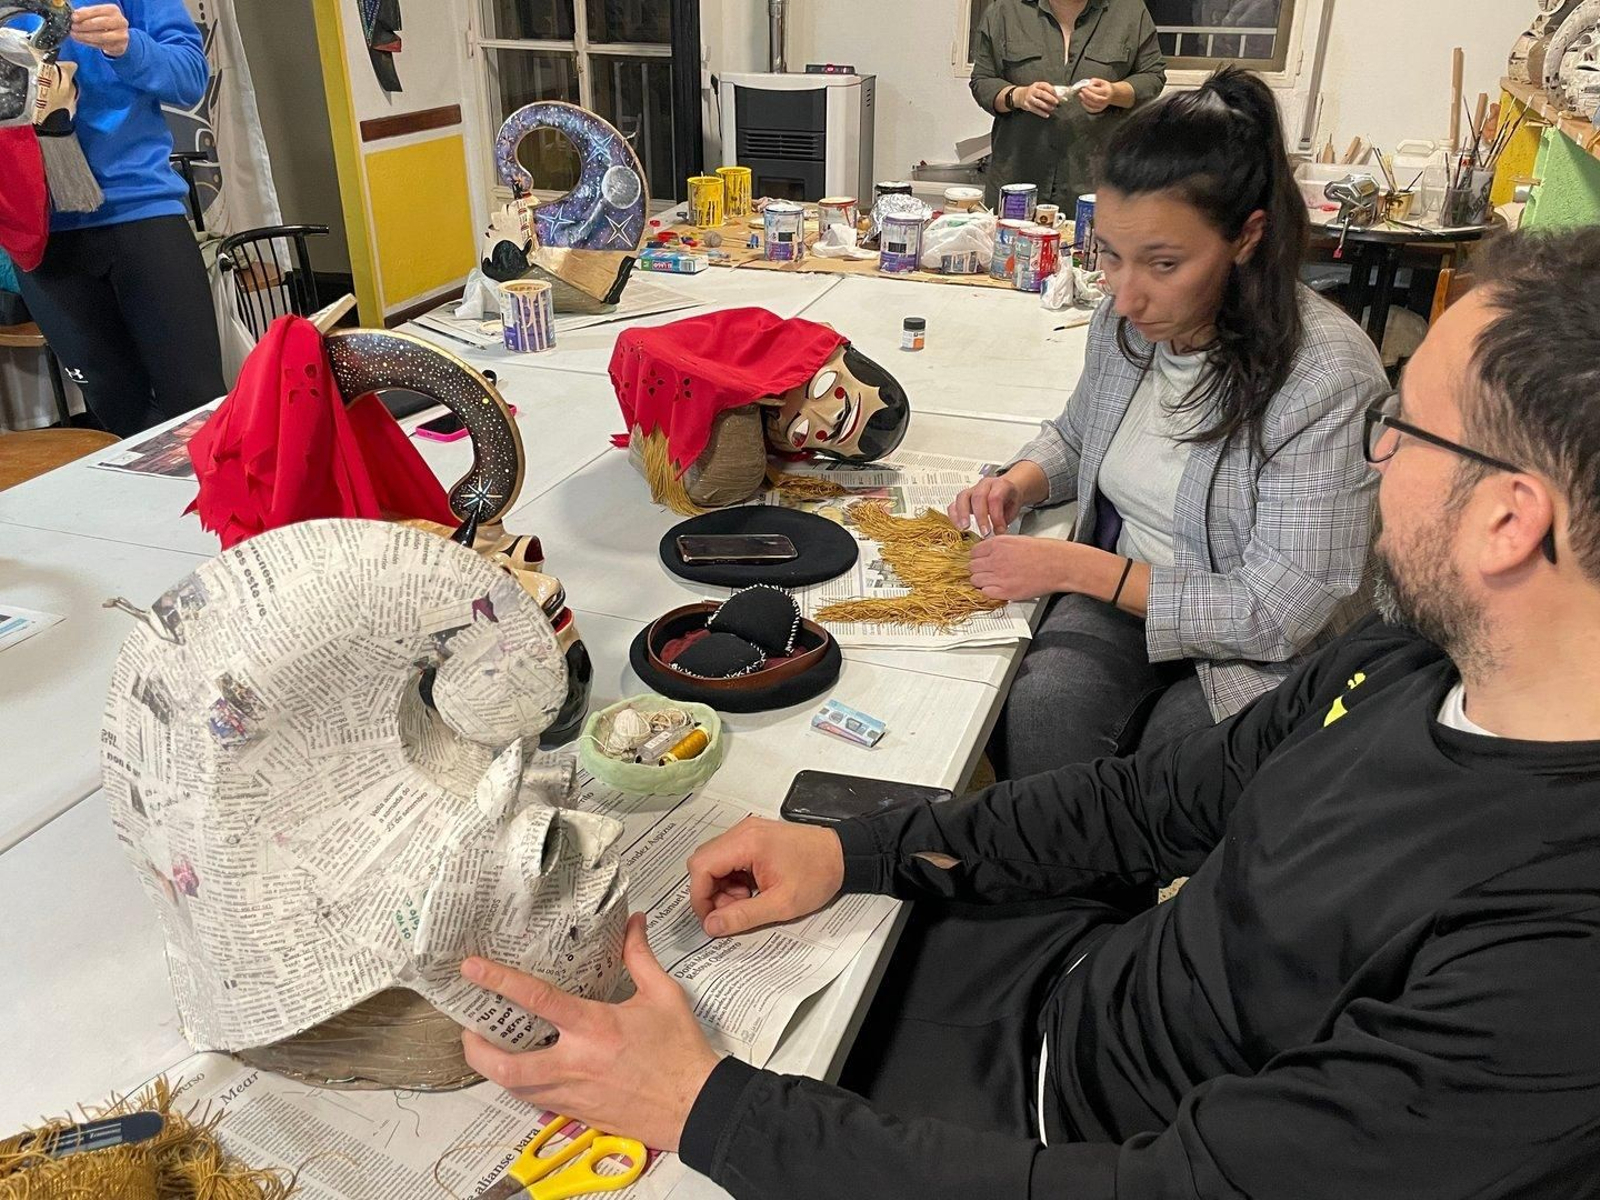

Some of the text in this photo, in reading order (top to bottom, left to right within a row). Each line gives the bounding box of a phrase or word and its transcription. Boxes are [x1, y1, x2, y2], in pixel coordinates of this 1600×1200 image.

[244, 568, 260, 599] este
[655, 895, 684, 920] Manuel
[489, 1024, 498, 1032] a
[511, 1032, 524, 1044] ao
[220, 1071, 260, 1106] Mear
[474, 1152, 516, 1196] alianse
[513, 1127, 541, 1155] para
